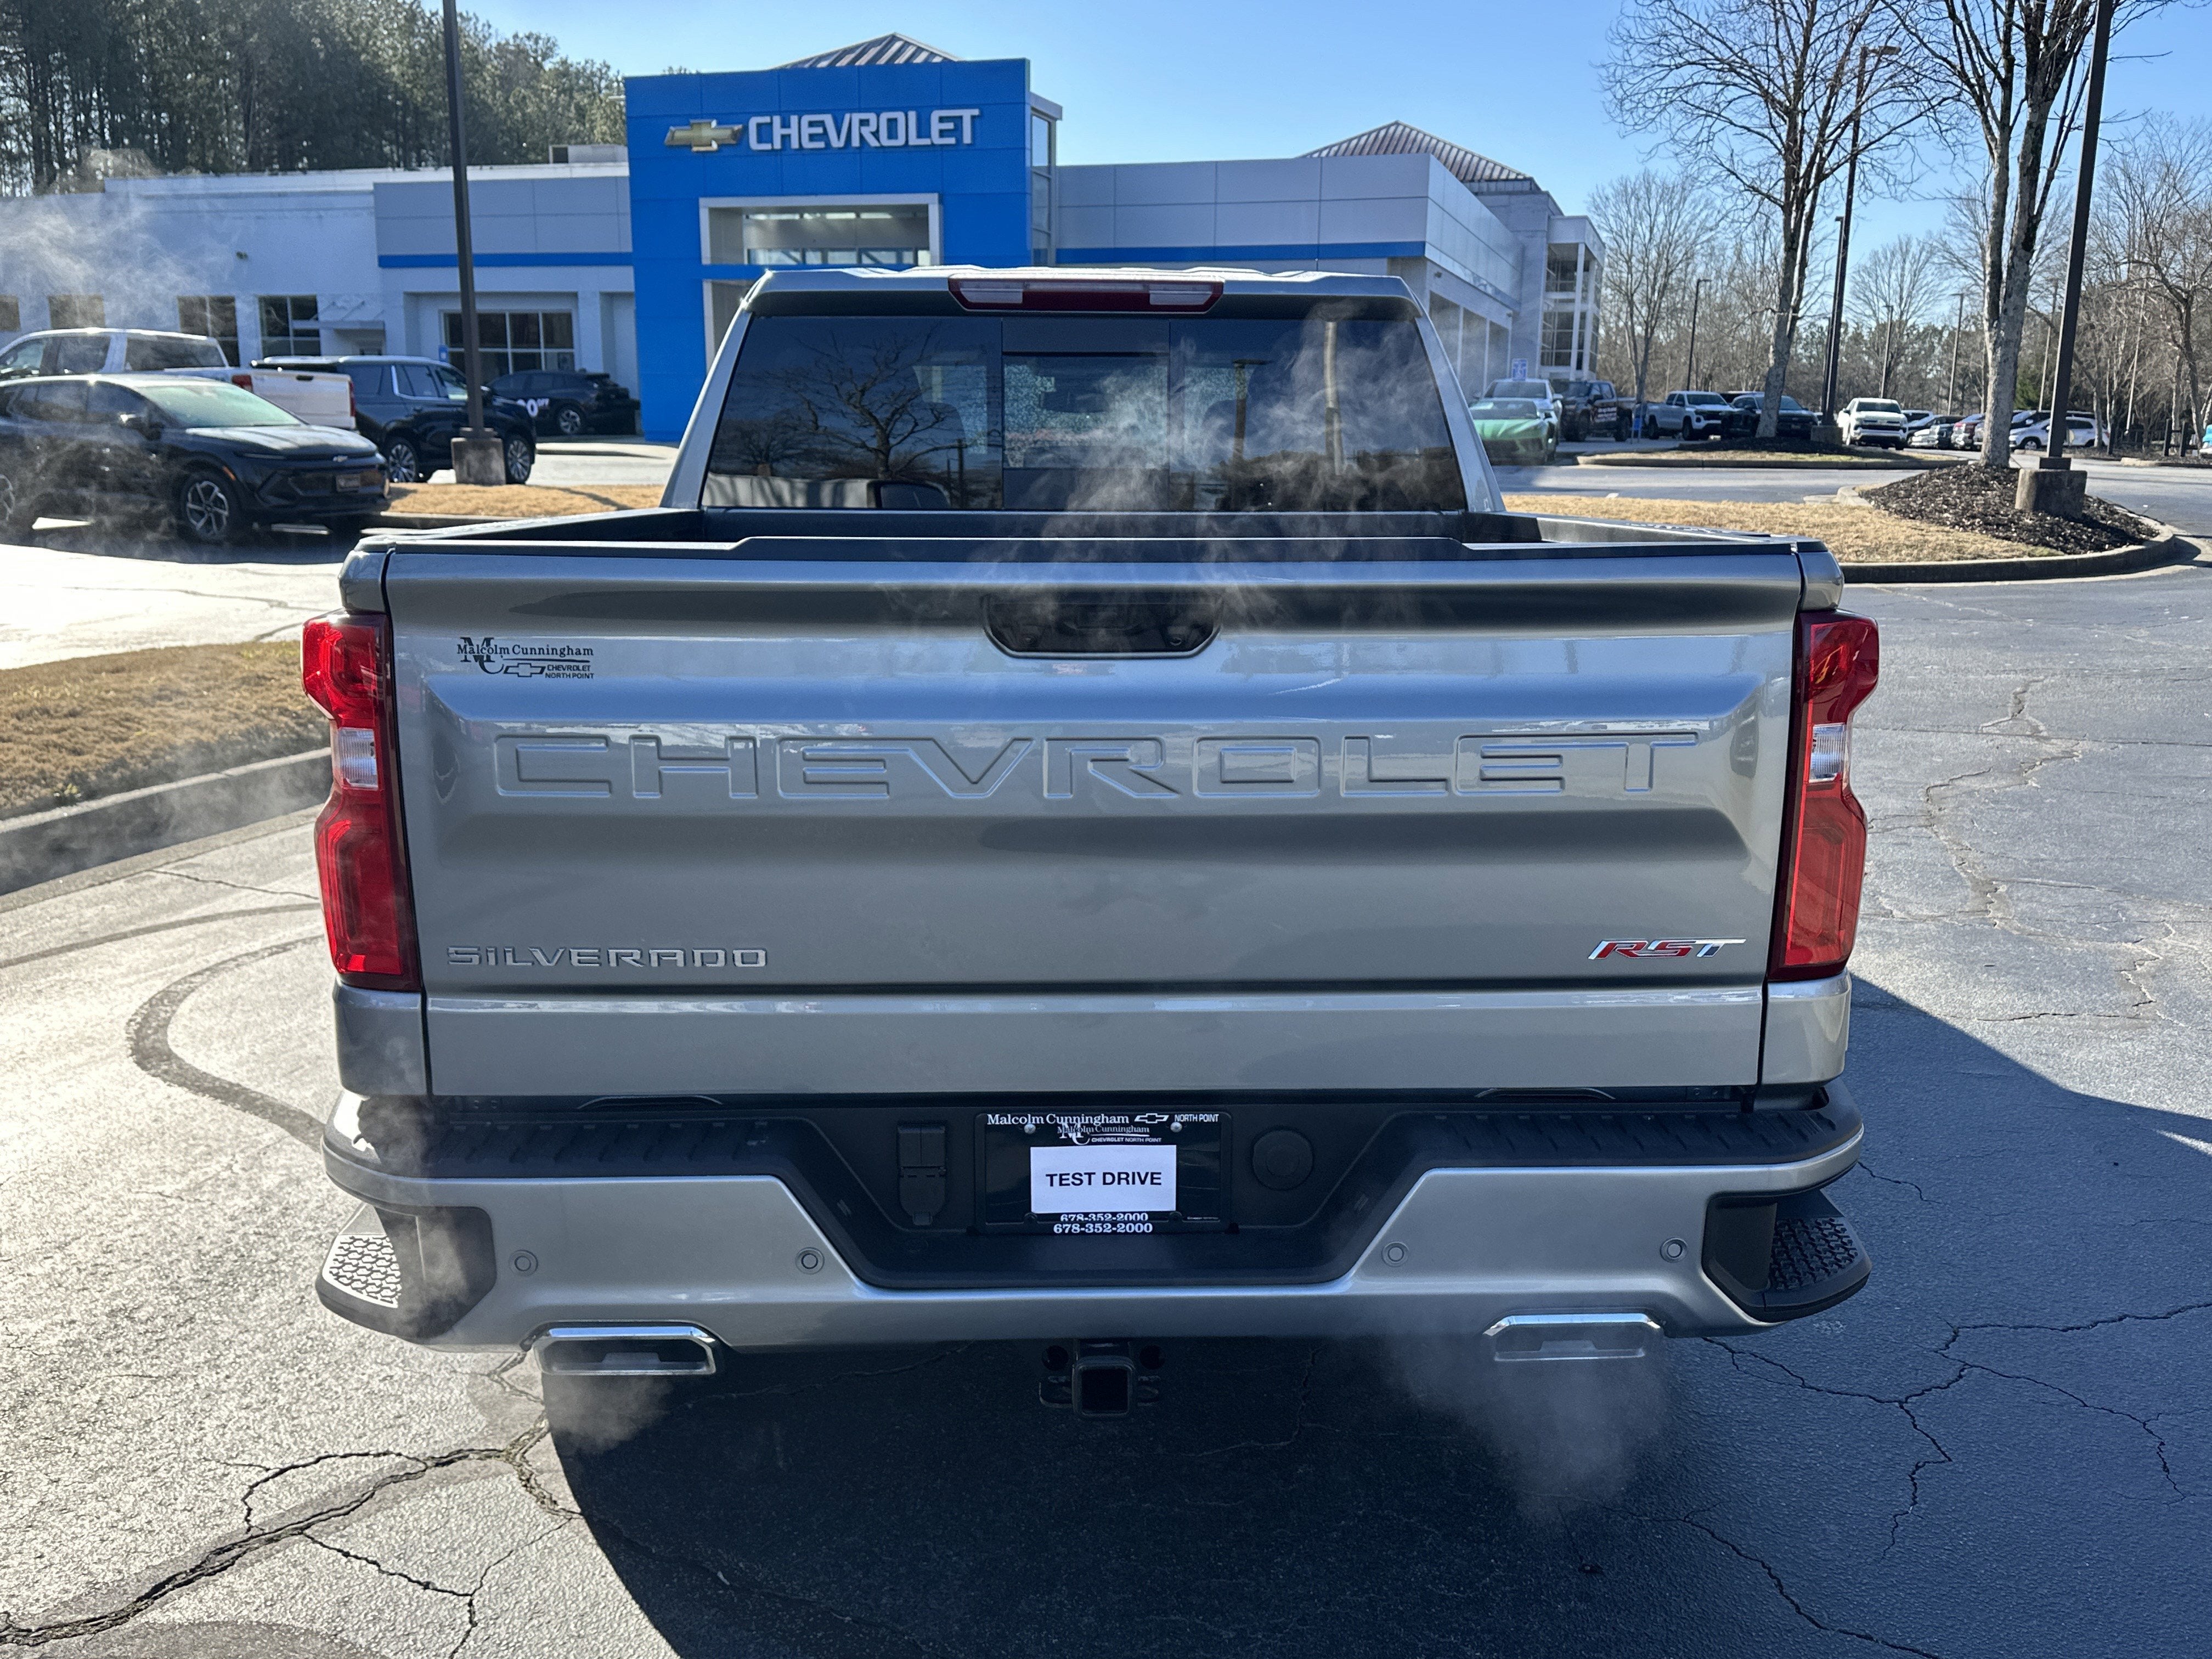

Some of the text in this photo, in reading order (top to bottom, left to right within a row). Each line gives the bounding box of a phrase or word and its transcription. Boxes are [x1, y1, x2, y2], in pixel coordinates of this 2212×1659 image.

[748, 109, 980, 150] CHEVROLET
[457, 644, 594, 657] Malcolm Cunningham
[494, 732, 1699, 799] CHEVROLET
[1588, 938, 1746, 960] RST
[447, 946, 768, 968] SILVERADO
[987, 1113, 1220, 1126] Malcolm Cunningham NORTH POINT
[1057, 1125, 1150, 1134] Malcolm Cunningham
[1046, 1171, 1162, 1187] TEST DRIVE
[1060, 1213, 1148, 1222] 678-352-2000
[1053, 1223, 1153, 1234] 678-352-2000
